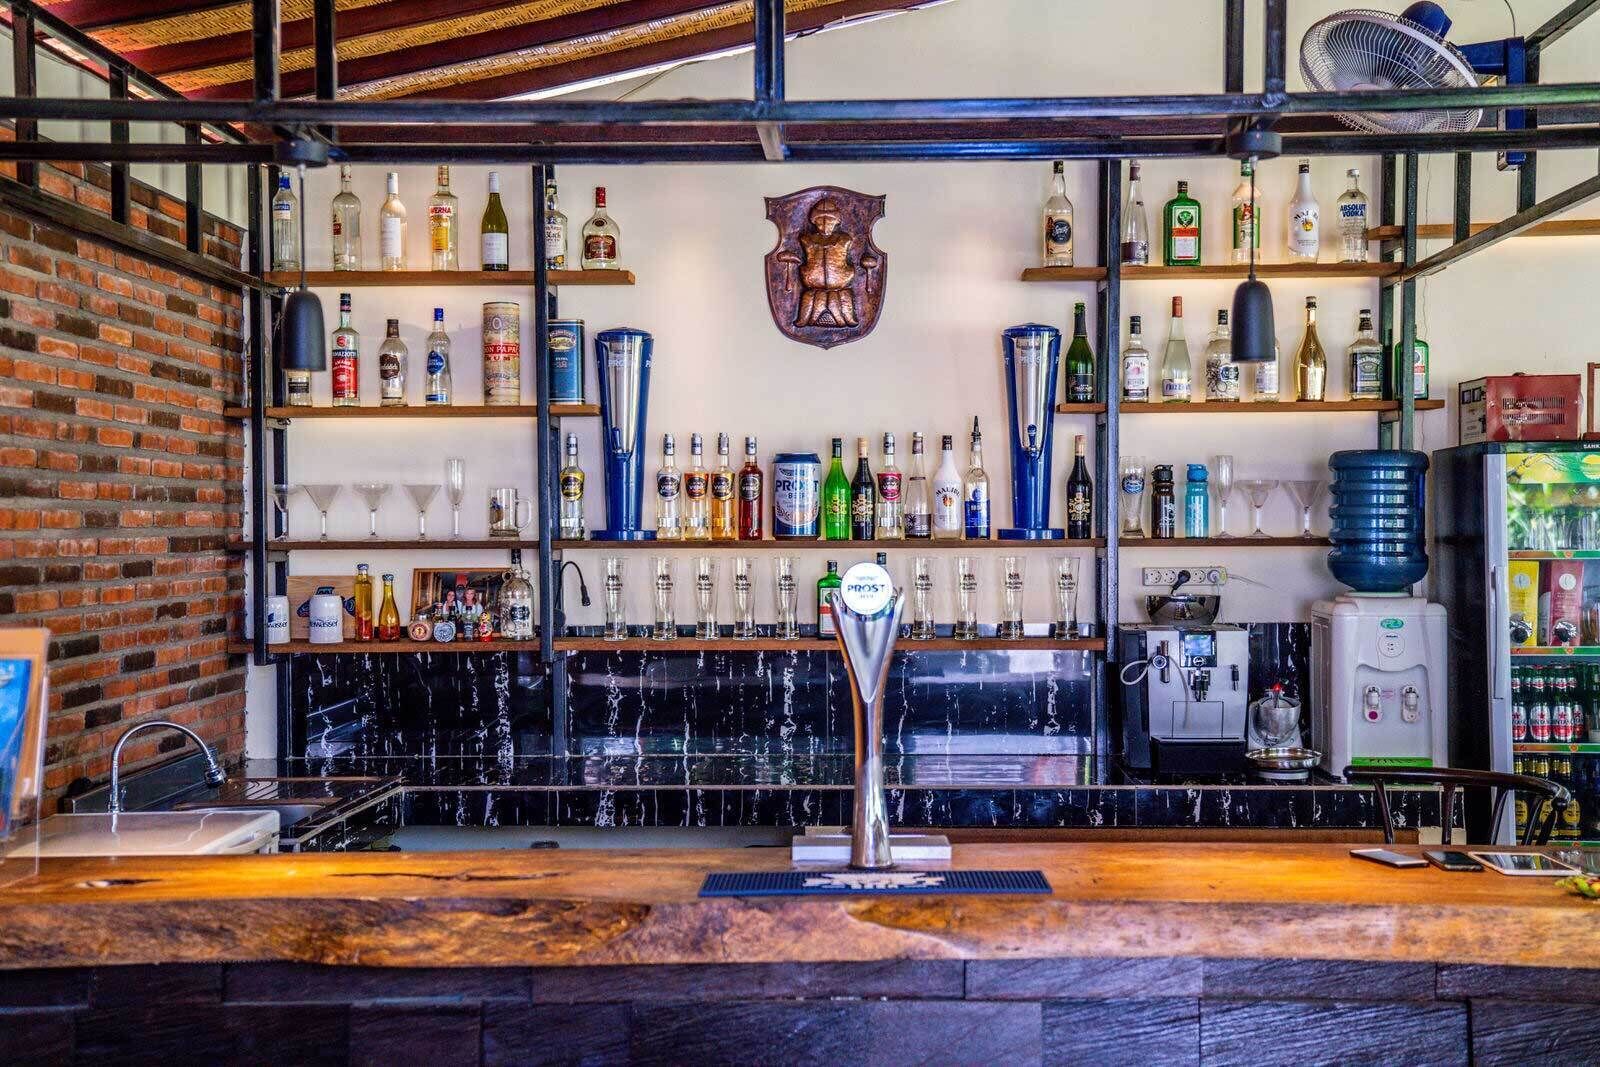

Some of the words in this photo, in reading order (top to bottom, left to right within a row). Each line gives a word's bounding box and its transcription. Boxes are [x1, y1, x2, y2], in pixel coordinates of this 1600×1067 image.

[1339, 204, 1366, 212] ABSOLUT
[775, 480, 819, 491] PROT
[847, 584, 885, 592] PROST
